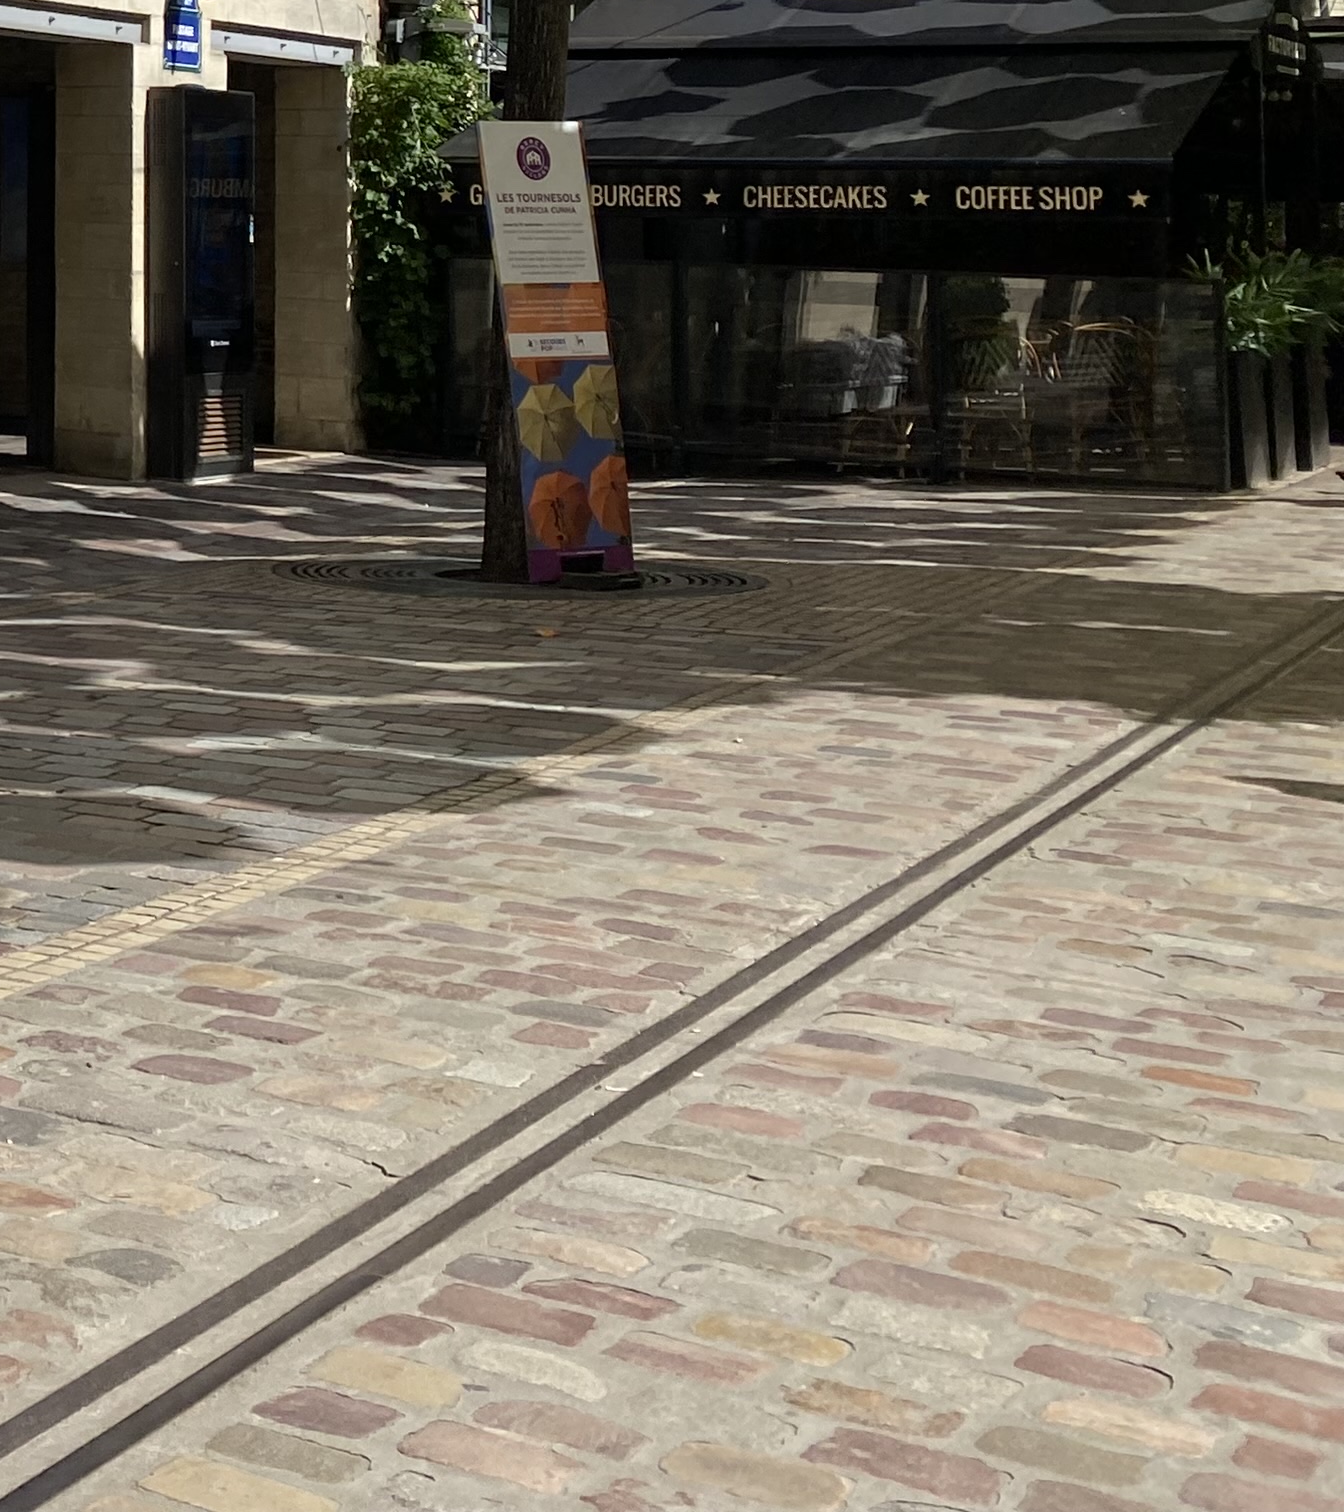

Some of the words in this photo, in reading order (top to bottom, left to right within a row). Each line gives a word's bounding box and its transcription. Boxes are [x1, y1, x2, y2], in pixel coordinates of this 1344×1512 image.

[496, 193, 514, 203] LES
[516, 193, 582, 203] TOURNESOLS
[591, 185, 681, 207] BURGERS
[743, 186, 888, 209] CHEESECAKES
[955, 186, 1035, 210] COFFEE
[1039, 187, 1103, 210] SHOP
[505, 206, 514, 214] DE
